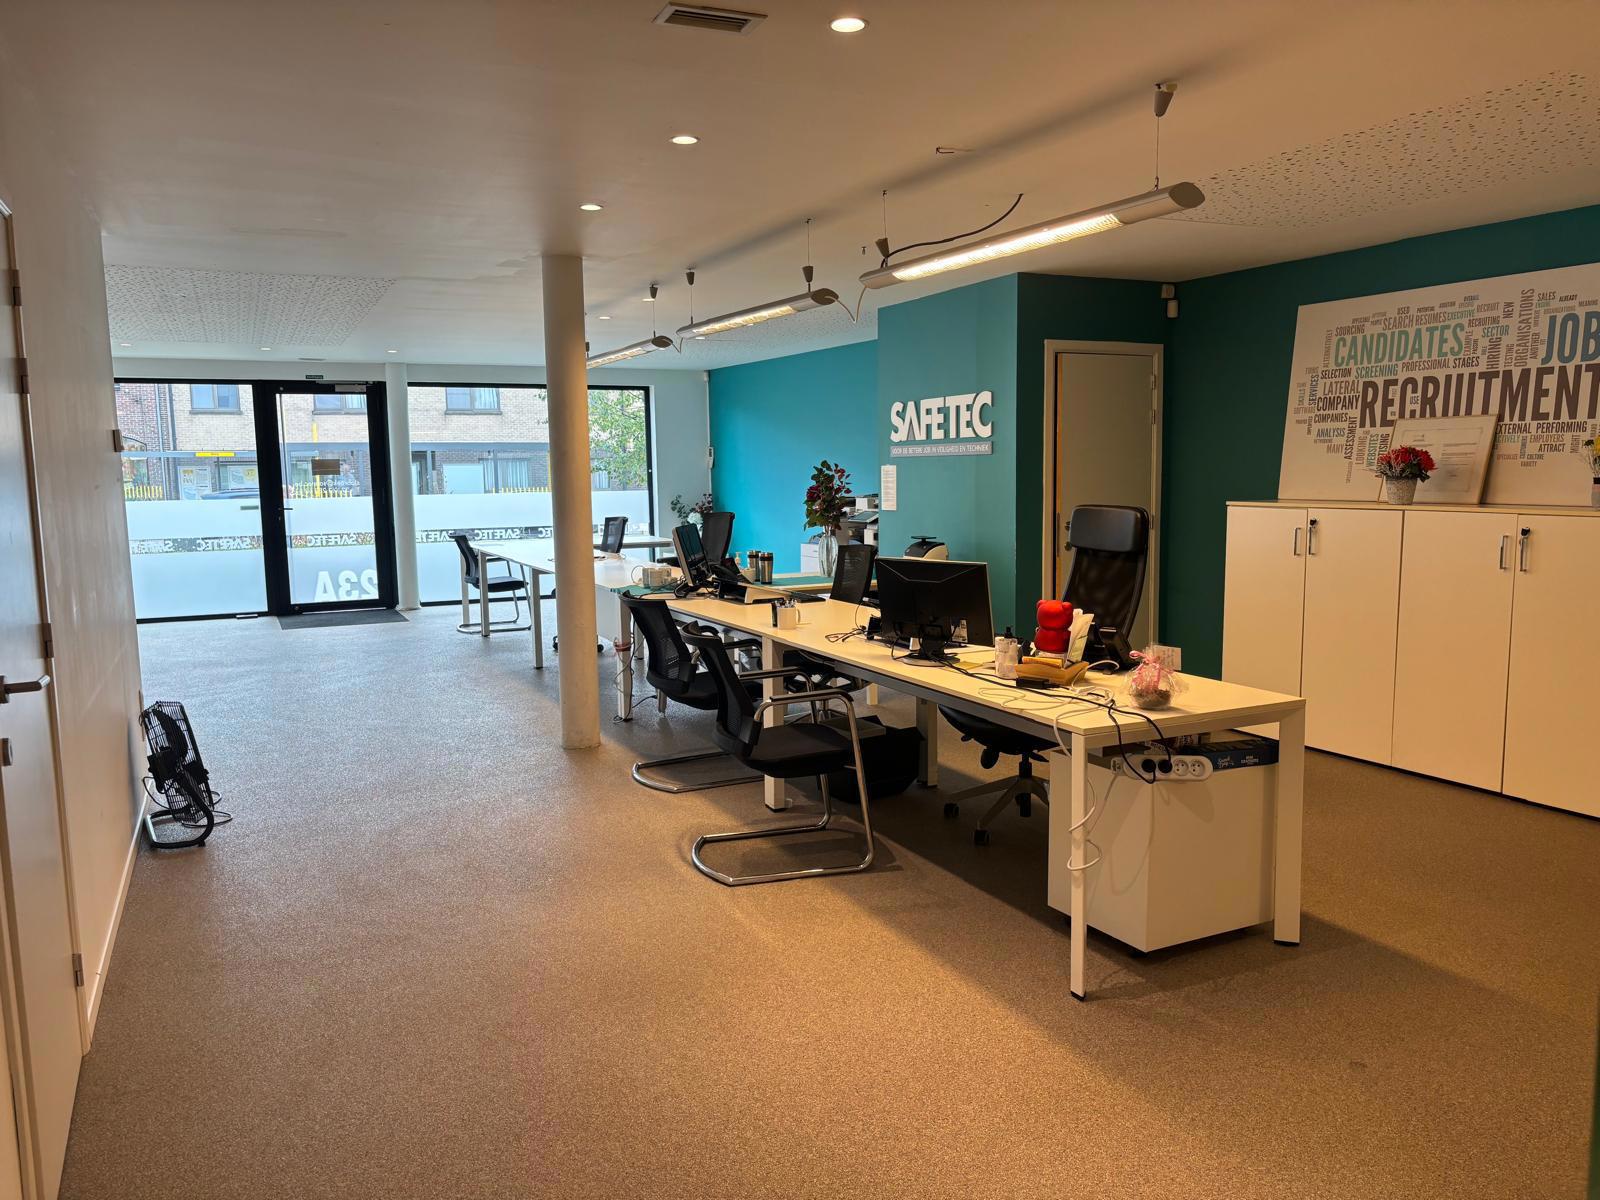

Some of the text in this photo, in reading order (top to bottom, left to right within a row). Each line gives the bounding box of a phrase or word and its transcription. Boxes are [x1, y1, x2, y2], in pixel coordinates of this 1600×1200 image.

[1538, 291, 1556, 301] SALES
[1447, 308, 1475, 320] EXECUTIVE
[1503, 302, 1514, 318] NEW
[1382, 314, 1414, 331] SEARCH
[1415, 311, 1446, 325] RESUMES
[1468, 316, 1500, 328] RECRUITING
[1335, 324, 1365, 337] SOURCING
[1482, 325, 1509, 338] SECTOR
[1514, 289, 1534, 367] ORGANISATIONS
[1334, 323, 1465, 367] CANDIDATES
[1463, 330, 1473, 356] EXAMPLE
[1530, 332, 1540, 359] ANOTHER
[1487, 337, 1502, 370] HIRING
[1504, 344, 1514, 368] TESTING
[1401, 358, 1450, 372] PROFESSIONAL
[1453, 356, 1480, 368] STAGES
[1321, 368, 1352, 379] SELECTION
[1355, 364, 1398, 379] SCREENING
[1308, 375, 1320, 405] SERVICES
[1323, 380, 1361, 396] LATERAL
[1317, 395, 1360, 412] COMPANY
[1410, 396, 1420, 405] USE
[890, 391, 992, 443] SAFETEC
[1314, 413, 1349, 423] COMPANIES
[1317, 428, 1346, 438] ANALYSIS
[1536, 421, 1587, 434] PERFORMING
[1344, 416, 1357, 460] ASSESSMENT
[1530, 434, 1564, 443] EMPLOYERS
[1326, 444, 1344, 454] MANY
[1355, 436, 1367, 464] LOOKING
[1366, 433, 1379, 467] WEBSITES
[1538, 443, 1565, 452] ATTRACT
